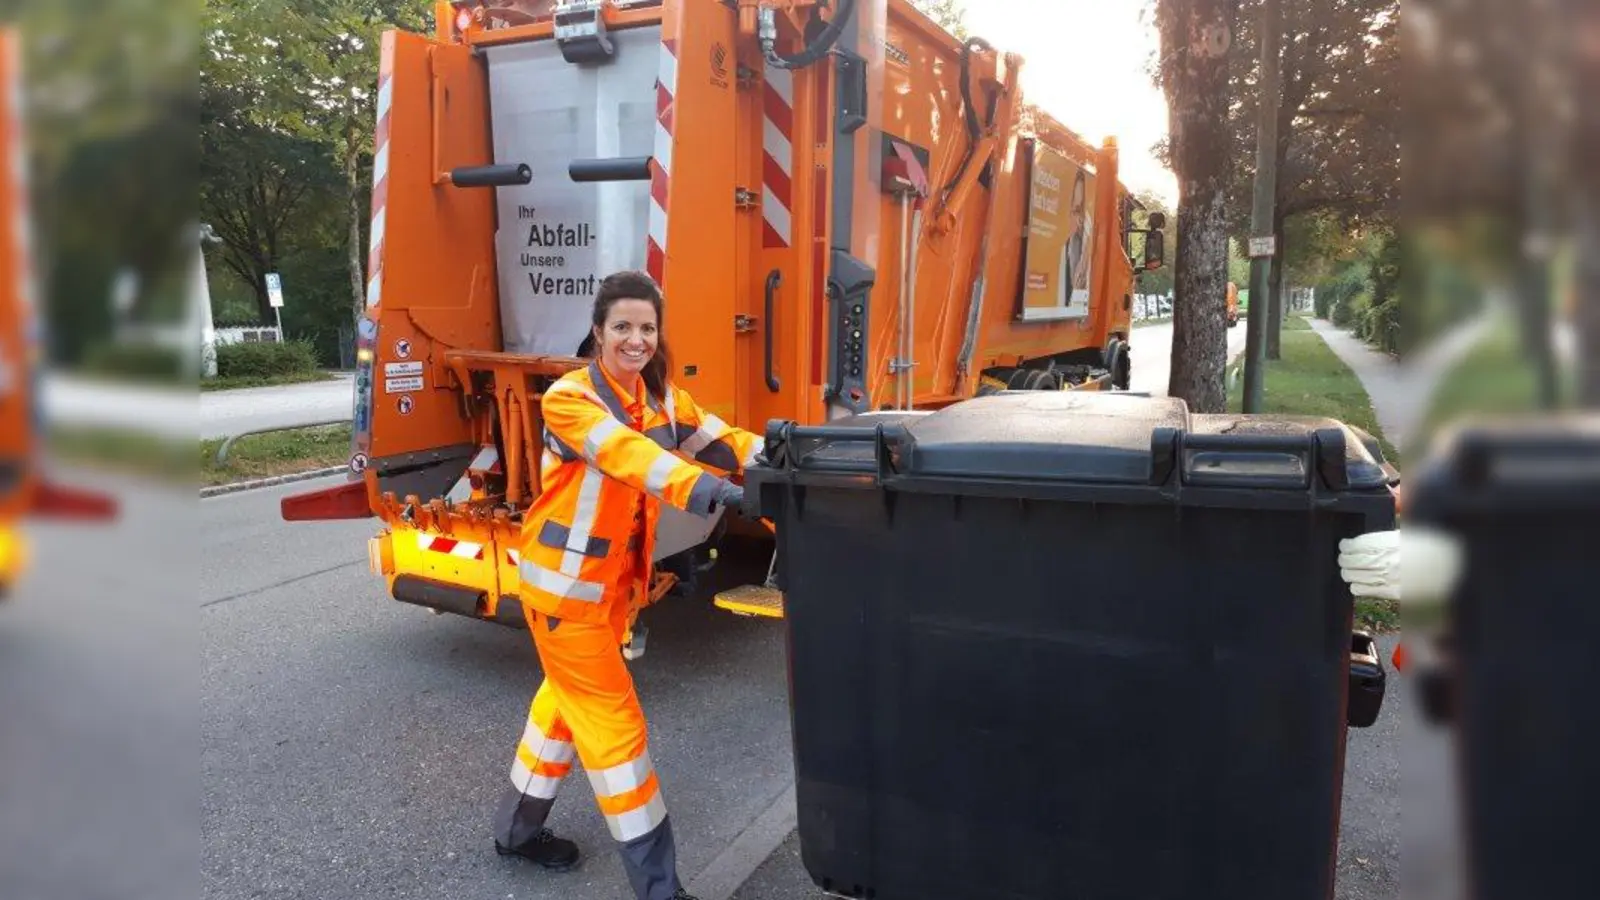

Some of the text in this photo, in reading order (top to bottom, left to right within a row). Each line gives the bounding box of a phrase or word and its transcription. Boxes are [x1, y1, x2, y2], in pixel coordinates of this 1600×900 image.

[518, 205, 535, 219] Ihr
[527, 223, 596, 247] Abfall-
[520, 253, 565, 267] Unsere
[528, 272, 602, 296] Verant
